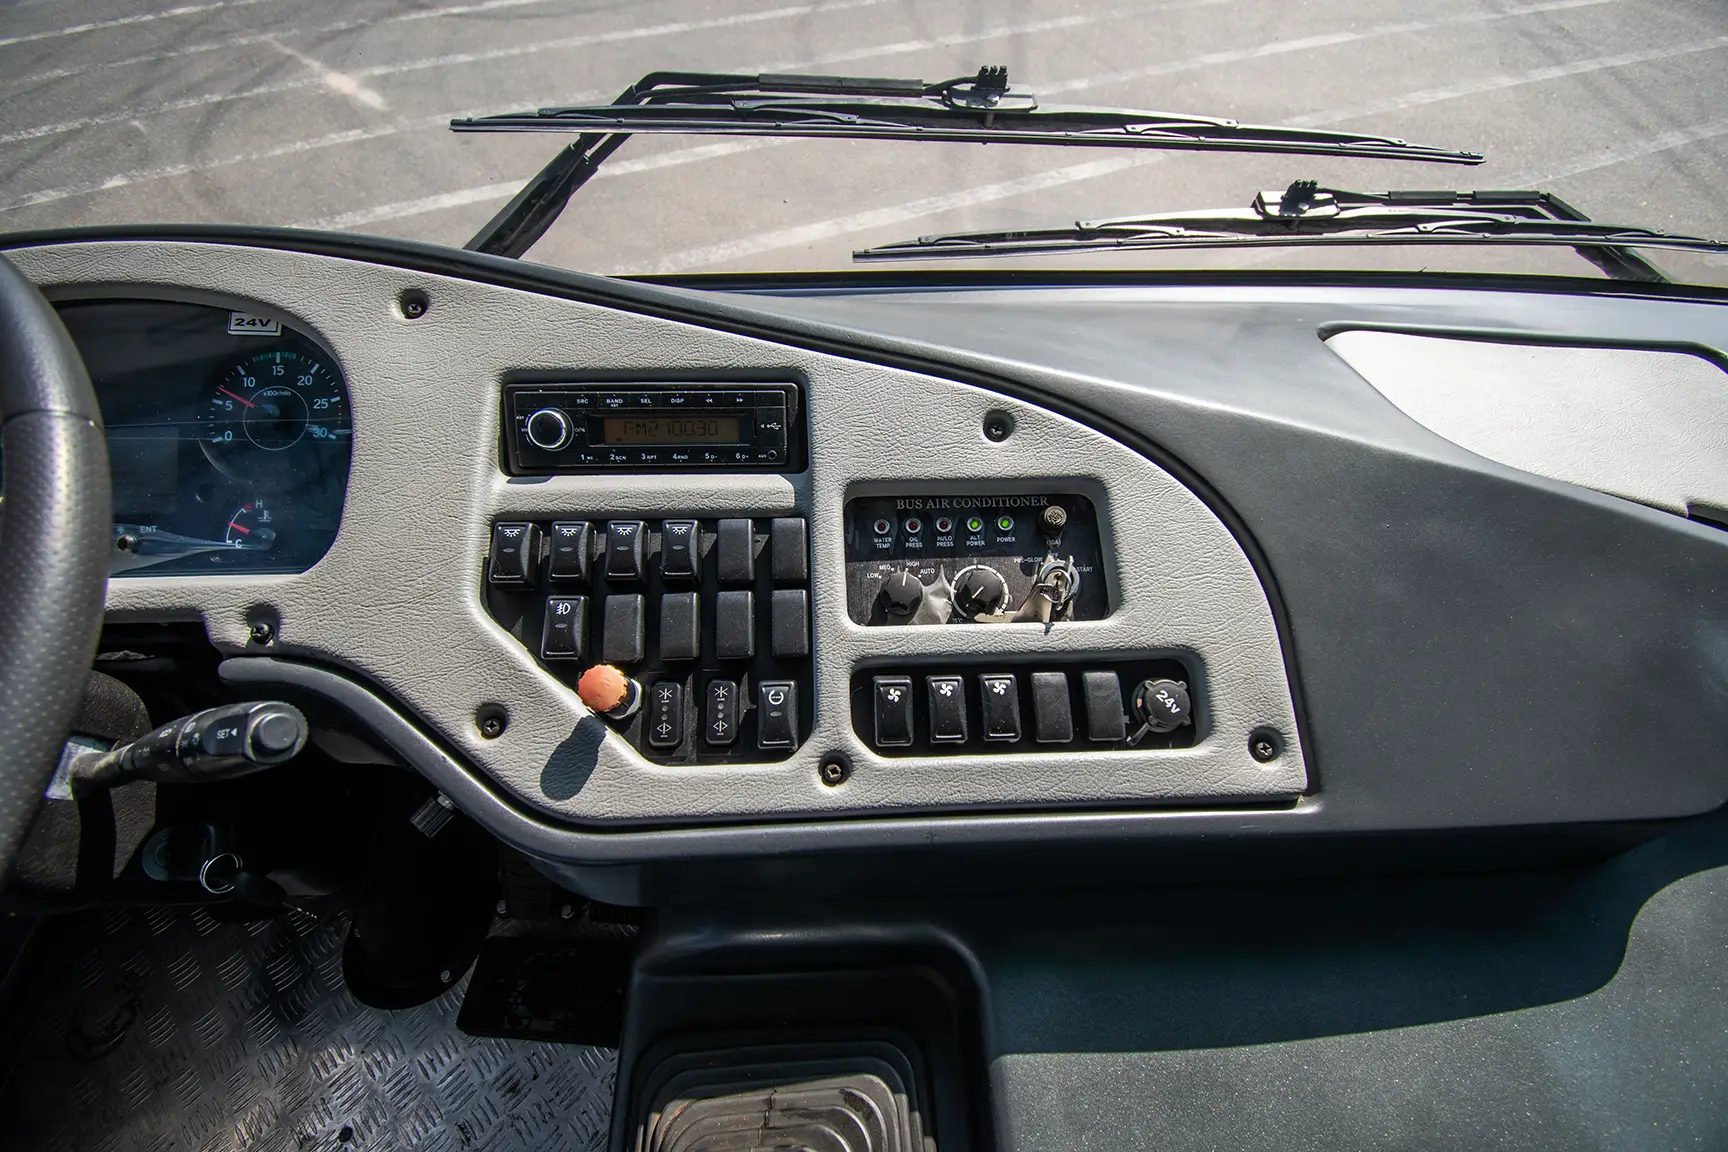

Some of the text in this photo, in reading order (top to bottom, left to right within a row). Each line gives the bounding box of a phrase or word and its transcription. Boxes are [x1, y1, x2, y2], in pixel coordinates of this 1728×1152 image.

[234, 317, 272, 328] 24V
[272, 365, 285, 376] 15
[243, 376, 256, 388] 10
[297, 375, 313, 386] 20
[225, 400, 233, 411] 5
[313, 399, 329, 410] 25
[312, 427, 328, 438] 30
[623, 420, 659, 437] FM2
[224, 430, 233, 441] 0
[255, 500, 263, 508] H
[896, 496, 1049, 510] BUS AIR CONDITIONER
[139, 525, 158, 534] ENT
[235, 539, 243, 549] C
[920, 567, 936, 575] AUTO
[216, 728, 231, 740] SET
